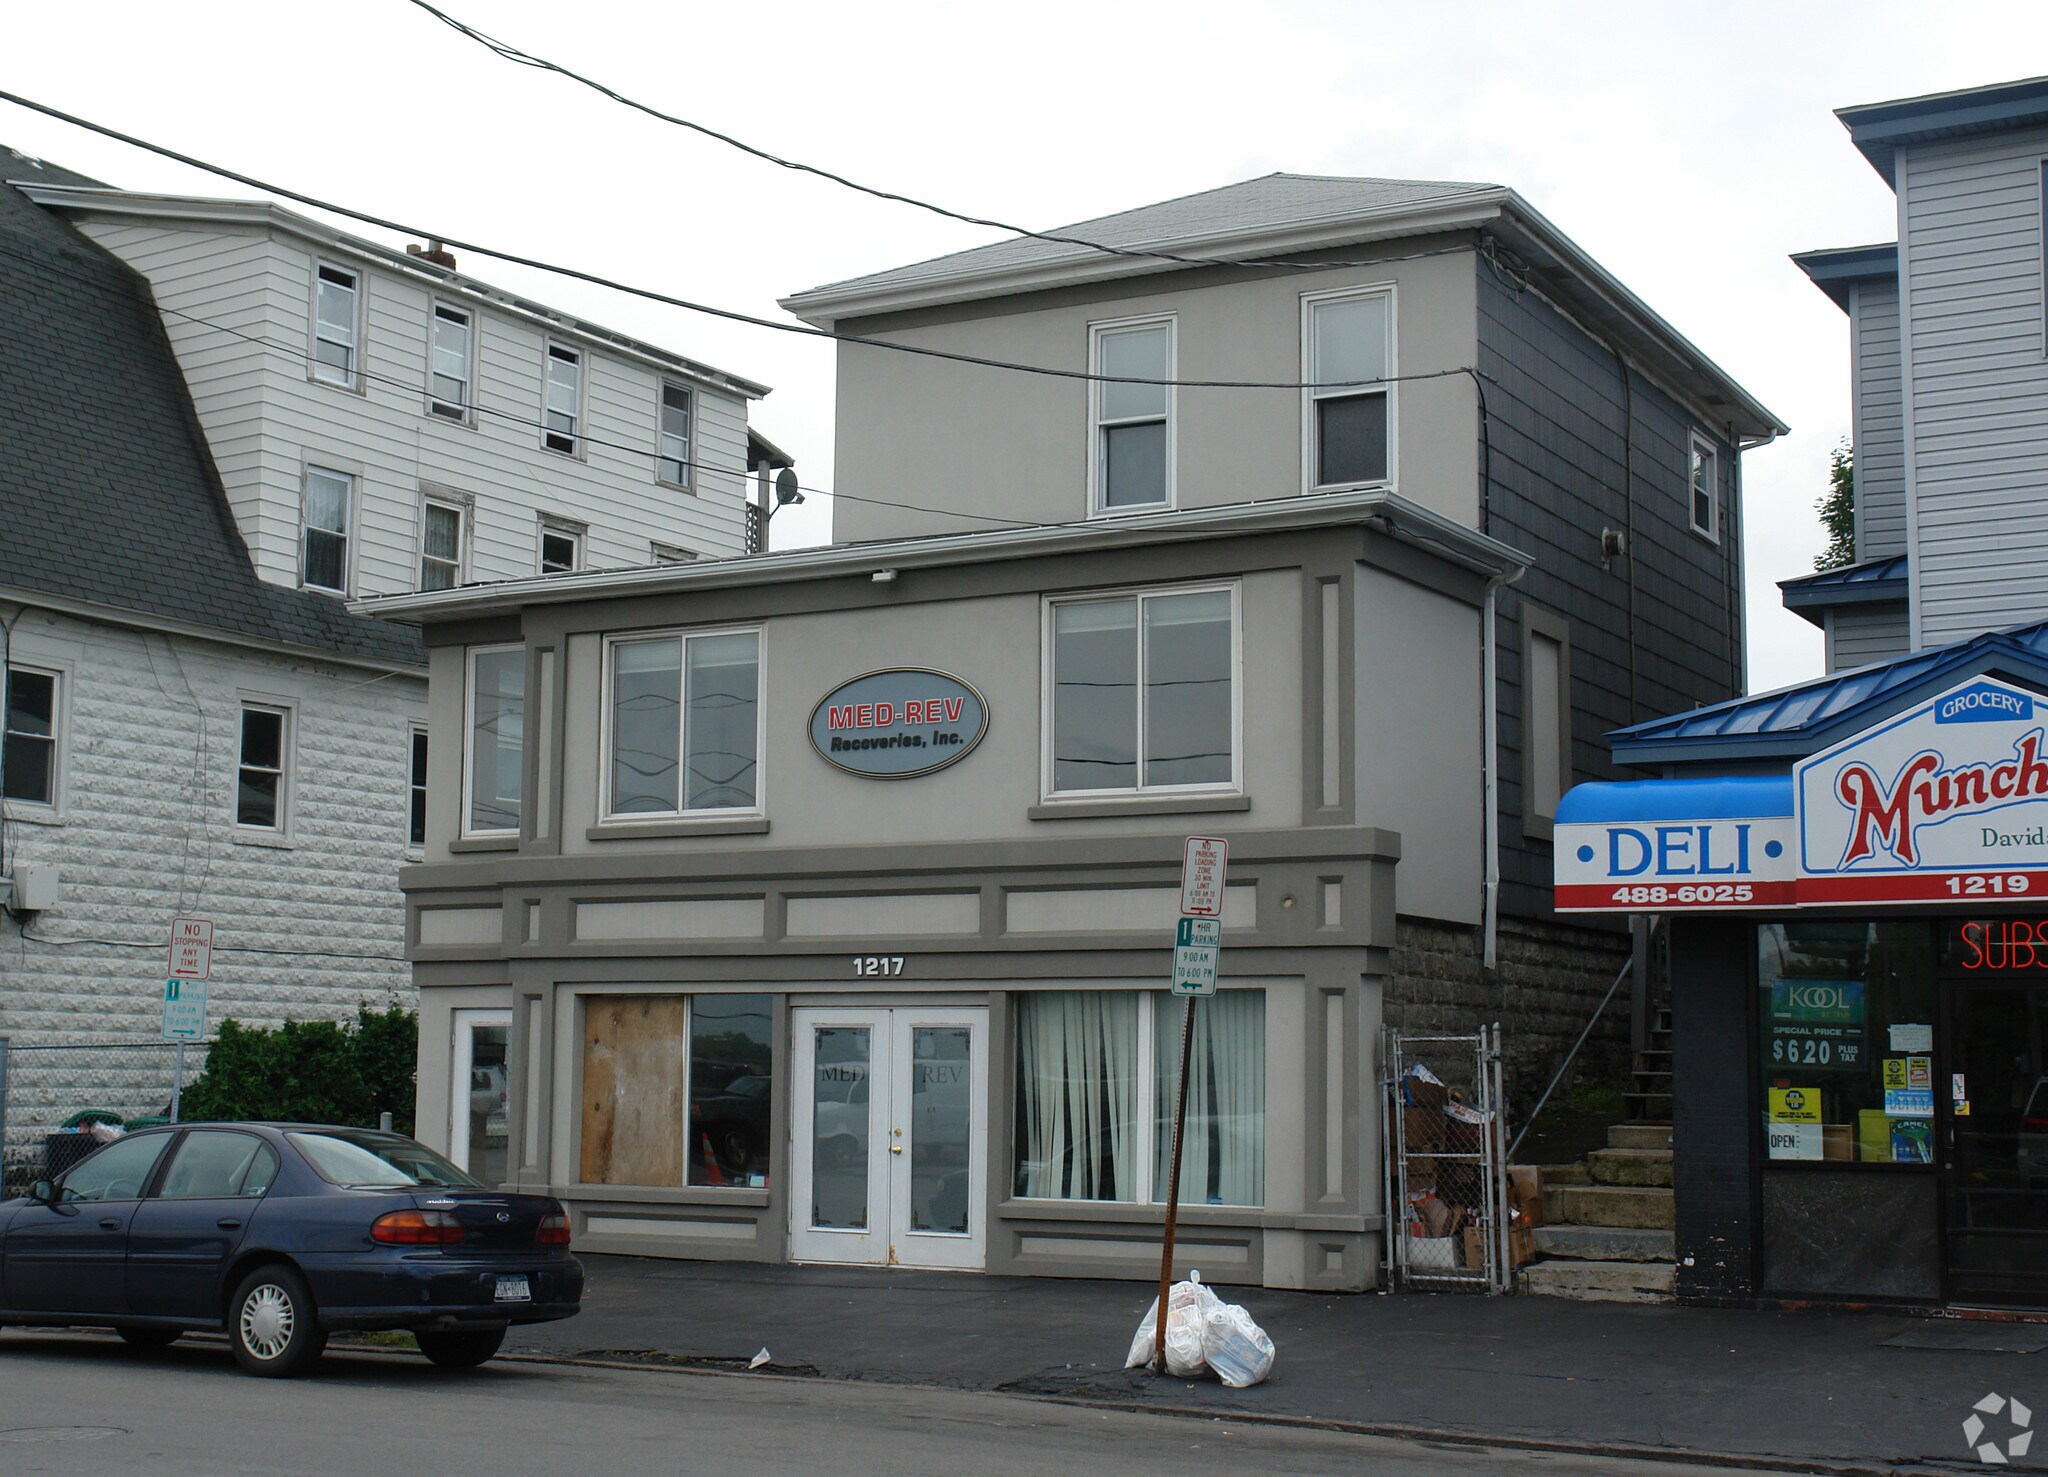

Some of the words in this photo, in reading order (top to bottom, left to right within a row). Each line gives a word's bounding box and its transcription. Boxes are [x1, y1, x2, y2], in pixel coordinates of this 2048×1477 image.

[1942, 692, 2024, 718] GROCERY
[828, 697, 965, 730] MED-REV
[831, 732, 926, 752] Recoveries,
[933, 731, 964, 746] Inc.
[1202, 842, 1211, 850] NO
[1606, 824, 1752, 877] DELI
[1945, 875, 2029, 895] 1219
[1612, 885, 1754, 903] 488-6025
[184, 924, 201, 935] NO
[1183, 921, 1187, 940] 1
[1200, 922, 1211, 932] HR
[174, 937, 208, 947] STOPPING
[1191, 935, 1218, 945] PARKING
[182, 949, 198, 957] ANY
[1199, 952, 1209, 962] AM
[180, 958, 199, 968] TIME
[853, 957, 906, 976] 1217
[1178, 967, 1186, 977] TO
[1203, 968, 1213, 978] PM
[1789, 986, 1850, 1009] KOOL
[1773, 1026, 1811, 1035] SPECIAL
[1813, 1028, 1842, 1036] PRICE
[1838, 1045, 1858, 1053] PLUS
[1840, 1053, 1856, 1062] TAX
[821, 1064, 865, 1082] MED
[922, 1065, 963, 1083] REV
[1897, 1121, 1929, 1129] CAMEL
[1771, 1134, 1795, 1148] OPEN
